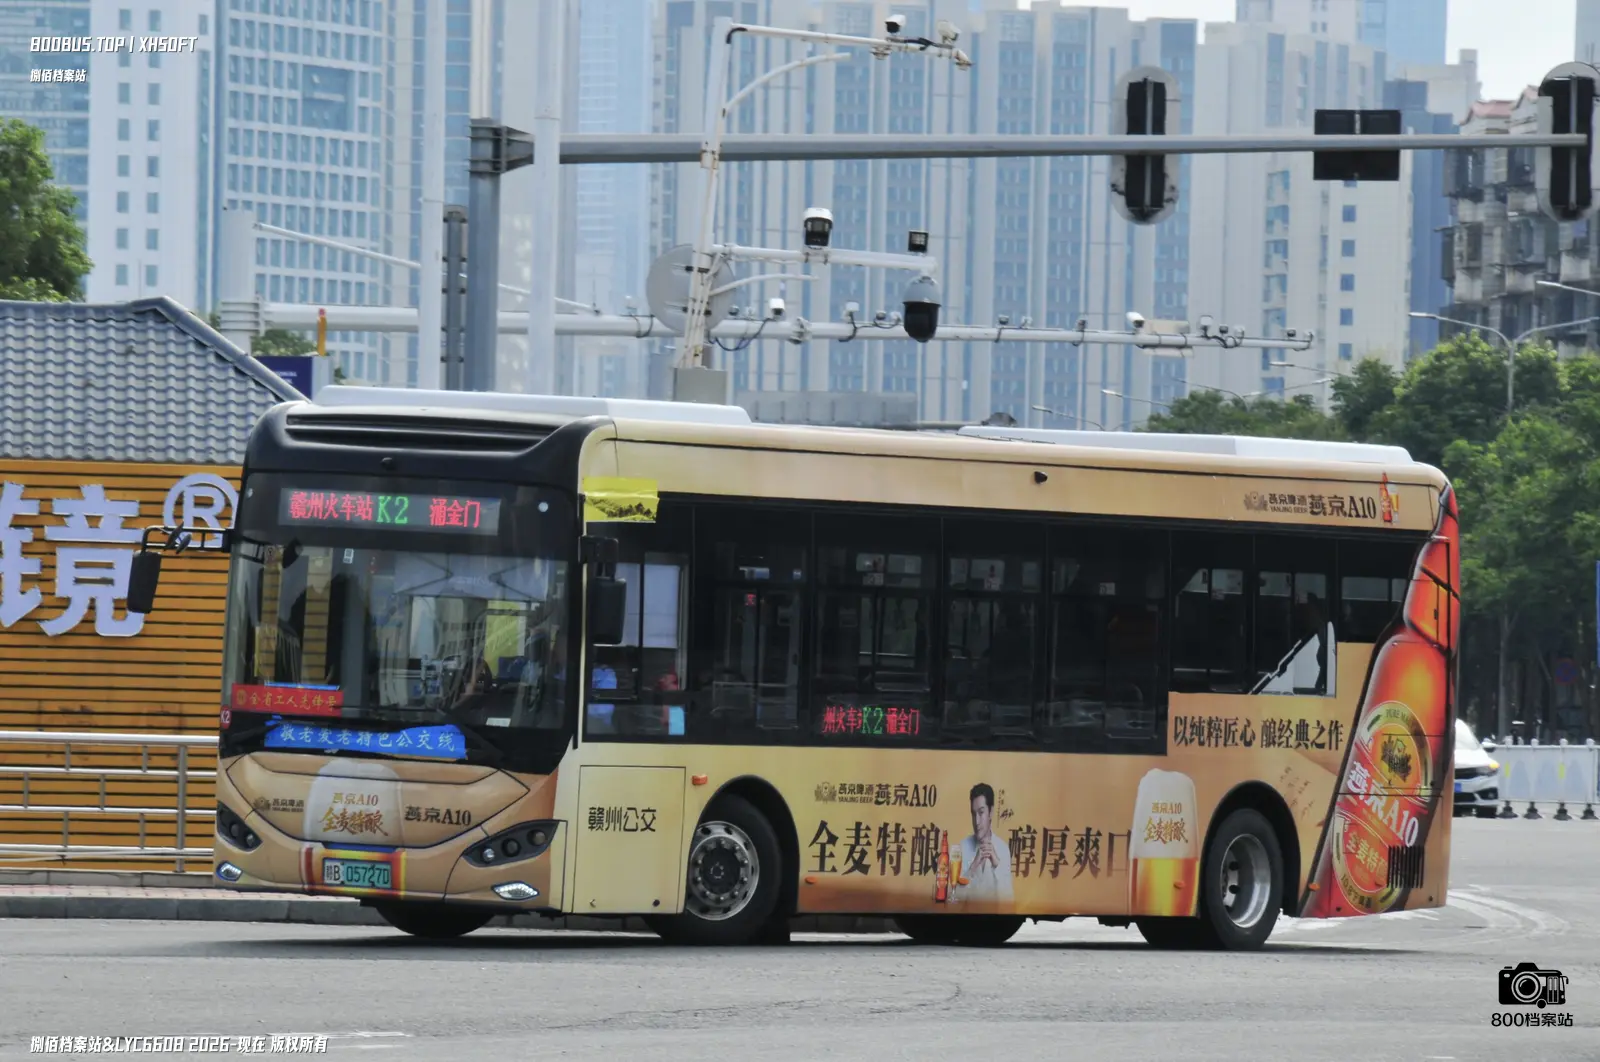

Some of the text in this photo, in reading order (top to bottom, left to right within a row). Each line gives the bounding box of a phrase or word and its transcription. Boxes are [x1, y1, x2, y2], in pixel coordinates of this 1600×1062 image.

[290, 491, 374, 520] 赣州火车站
[376, 495, 409, 524] K2
[1308, 494, 1377, 519] 燕京A10
[862, 706, 883, 734] K2
[1173, 715, 1344, 751] 以纯粹匠心 酿经典之作
[874, 783, 938, 808] 燕京A10
[404, 805, 472, 826] 燕京A10
[588, 806, 657, 832] 赣州公交
[807, 820, 1132, 880] 全麦特酿 醇厚爽口
